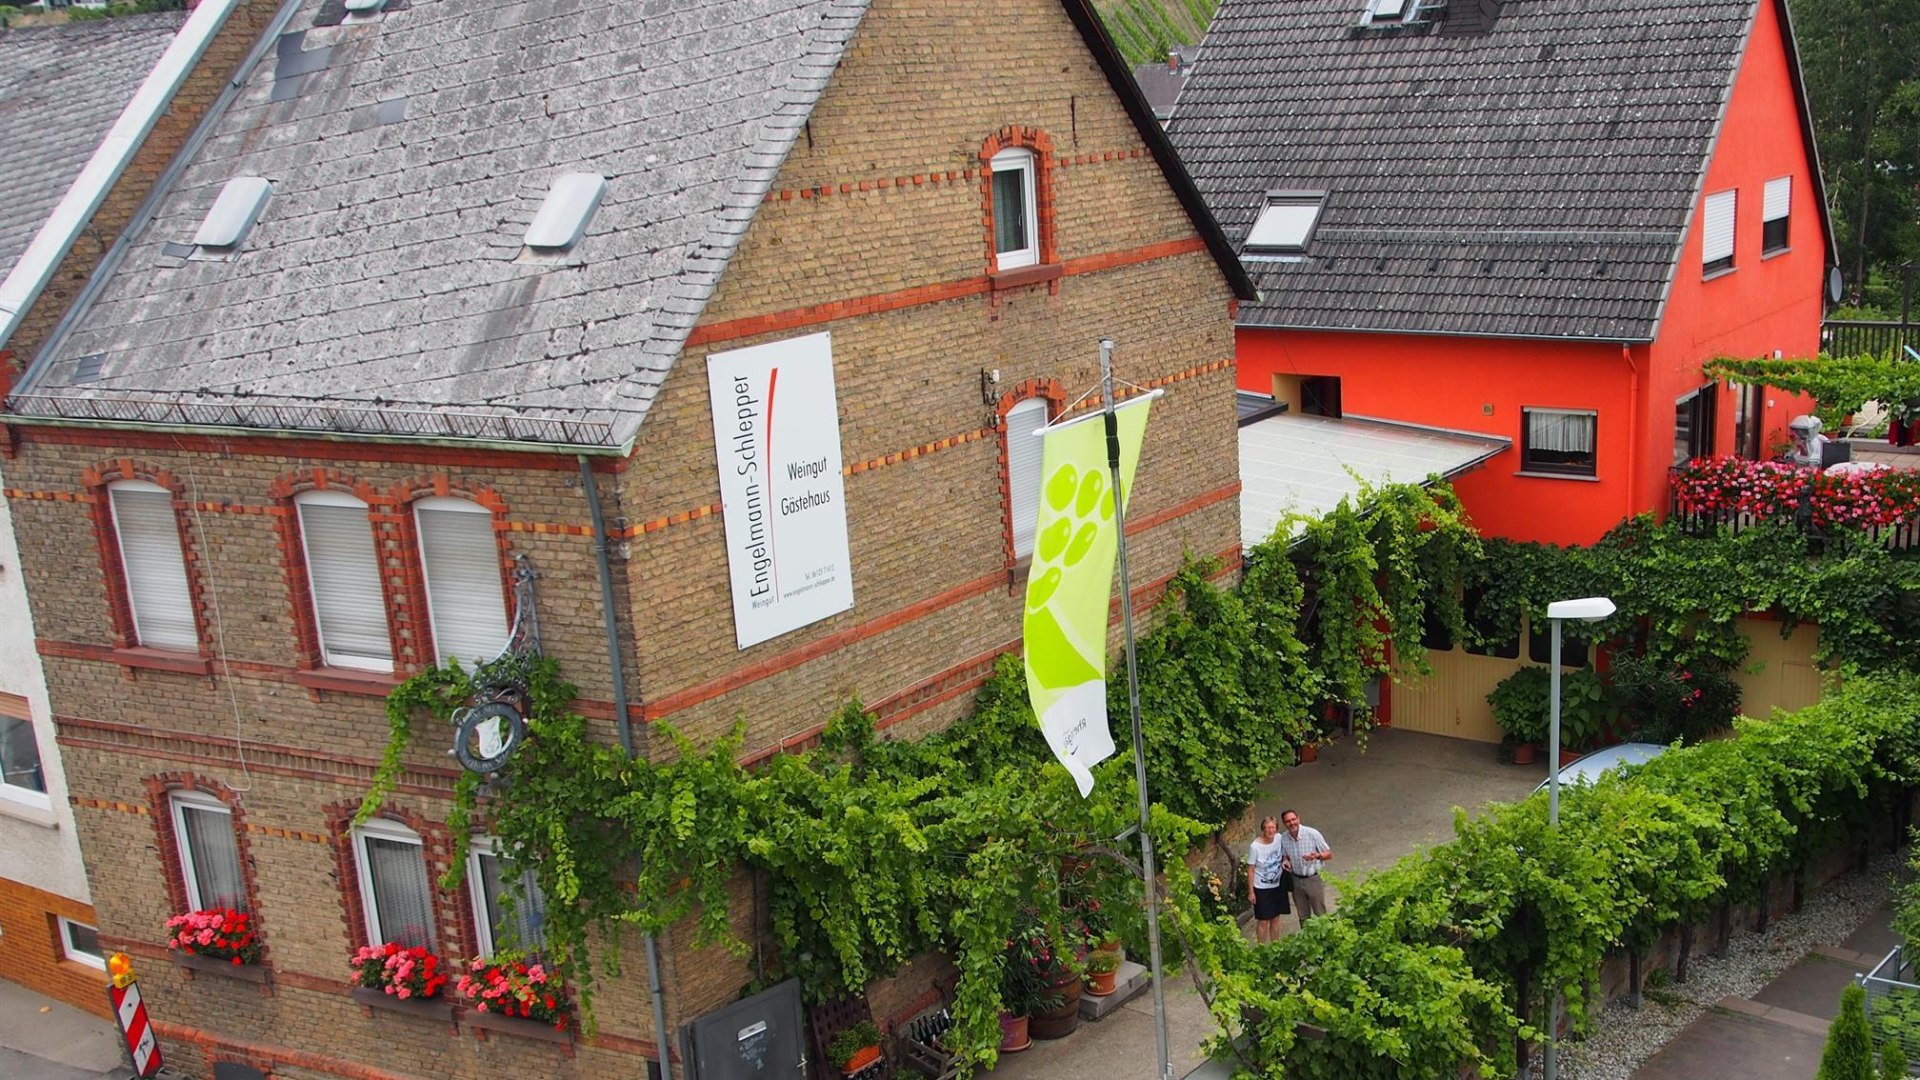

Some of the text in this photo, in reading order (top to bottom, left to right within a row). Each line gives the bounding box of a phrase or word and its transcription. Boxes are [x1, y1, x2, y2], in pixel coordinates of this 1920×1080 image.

[787, 456, 828, 481] Weingut
[733, 375, 771, 597] Engelmann-Schlepper
[781, 488, 831, 517] Gästehaus
[752, 596, 774, 609] Weingut
